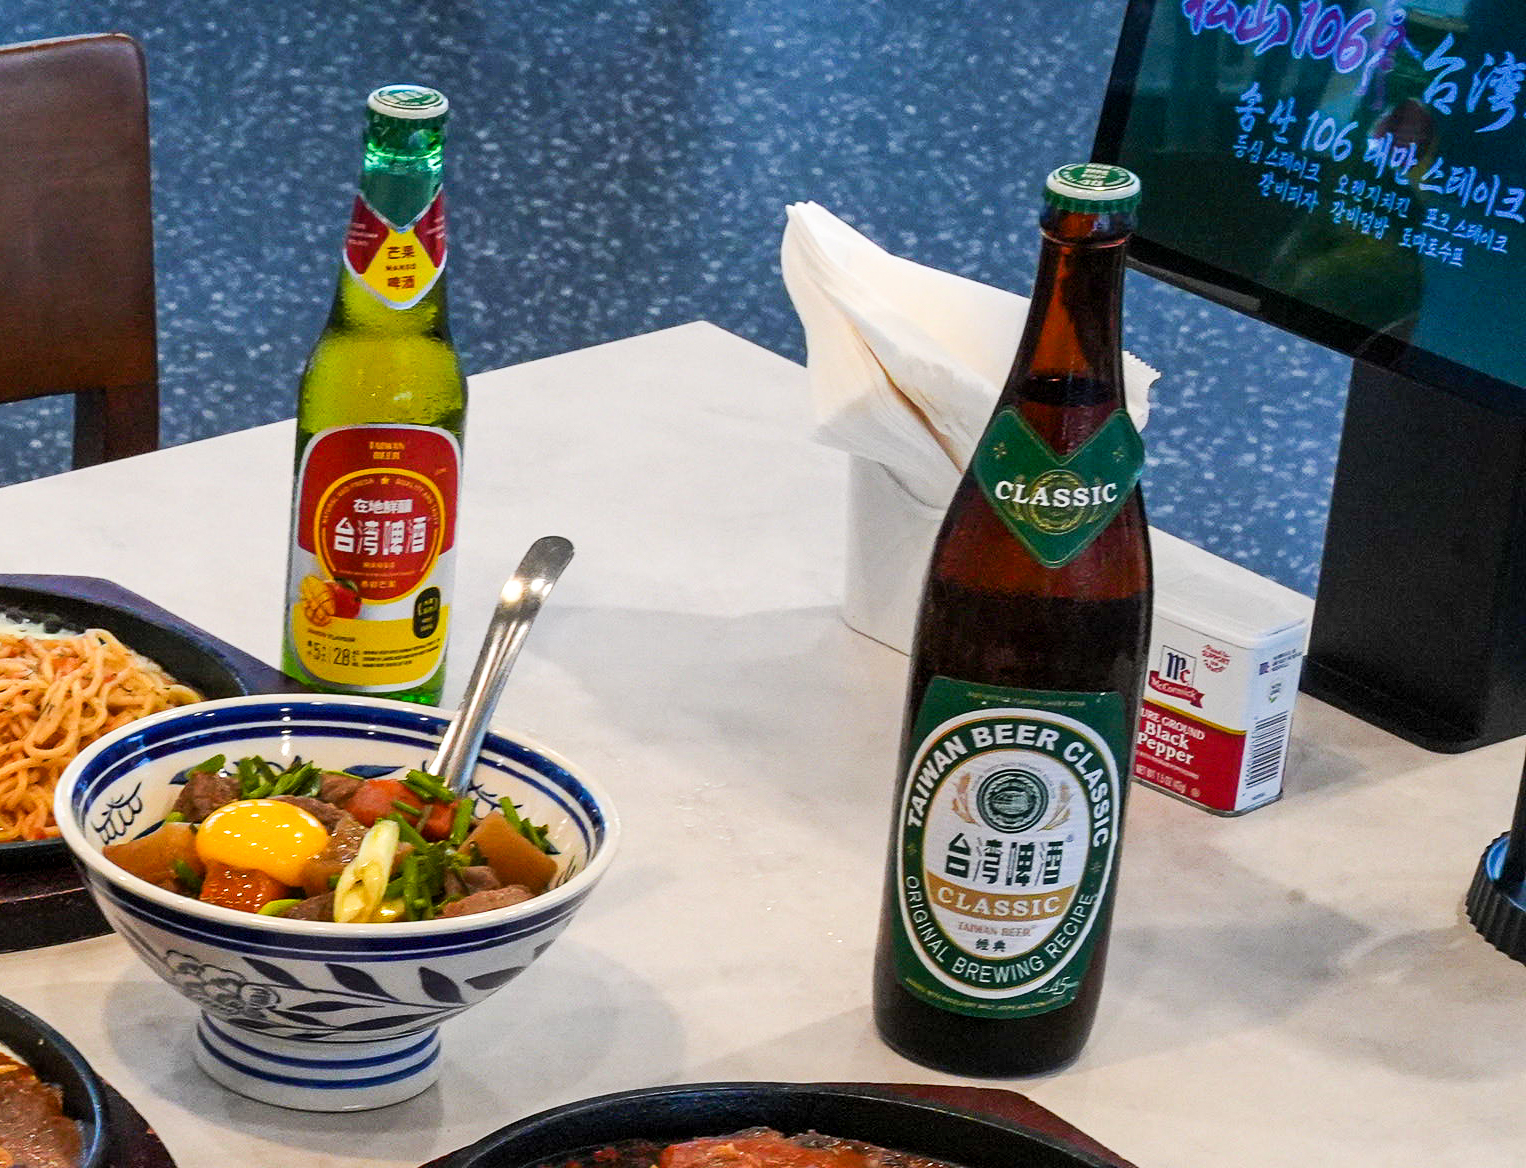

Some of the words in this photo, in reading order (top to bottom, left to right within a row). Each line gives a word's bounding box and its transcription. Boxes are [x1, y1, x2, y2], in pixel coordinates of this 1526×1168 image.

[1301, 110, 1359, 162] 106
[1363, 131, 1419, 186] 대만
[1418, 156, 1526, 224] 스테이크
[995, 480, 1118, 508] CLASSIC
[1141, 708, 1160, 722] URE
[1161, 716, 1205, 740] GROUND
[1144, 721, 1189, 750] Black
[1136, 732, 1194, 765] Pepper
[907, 735, 969, 828] TAIWAN
[970, 724, 1061, 751] BEER
[1063, 741, 1110, 848] CLASSIC
[937, 887, 1061, 917] CLASSIC
[905, 875, 949, 963] ORIGINAL
[951, 955, 1045, 984] BREWING
[1044, 894, 1094, 960] RECIPE
[958, 921, 998, 936] TAIWAN
[1001, 925, 1032, 937] BEER
